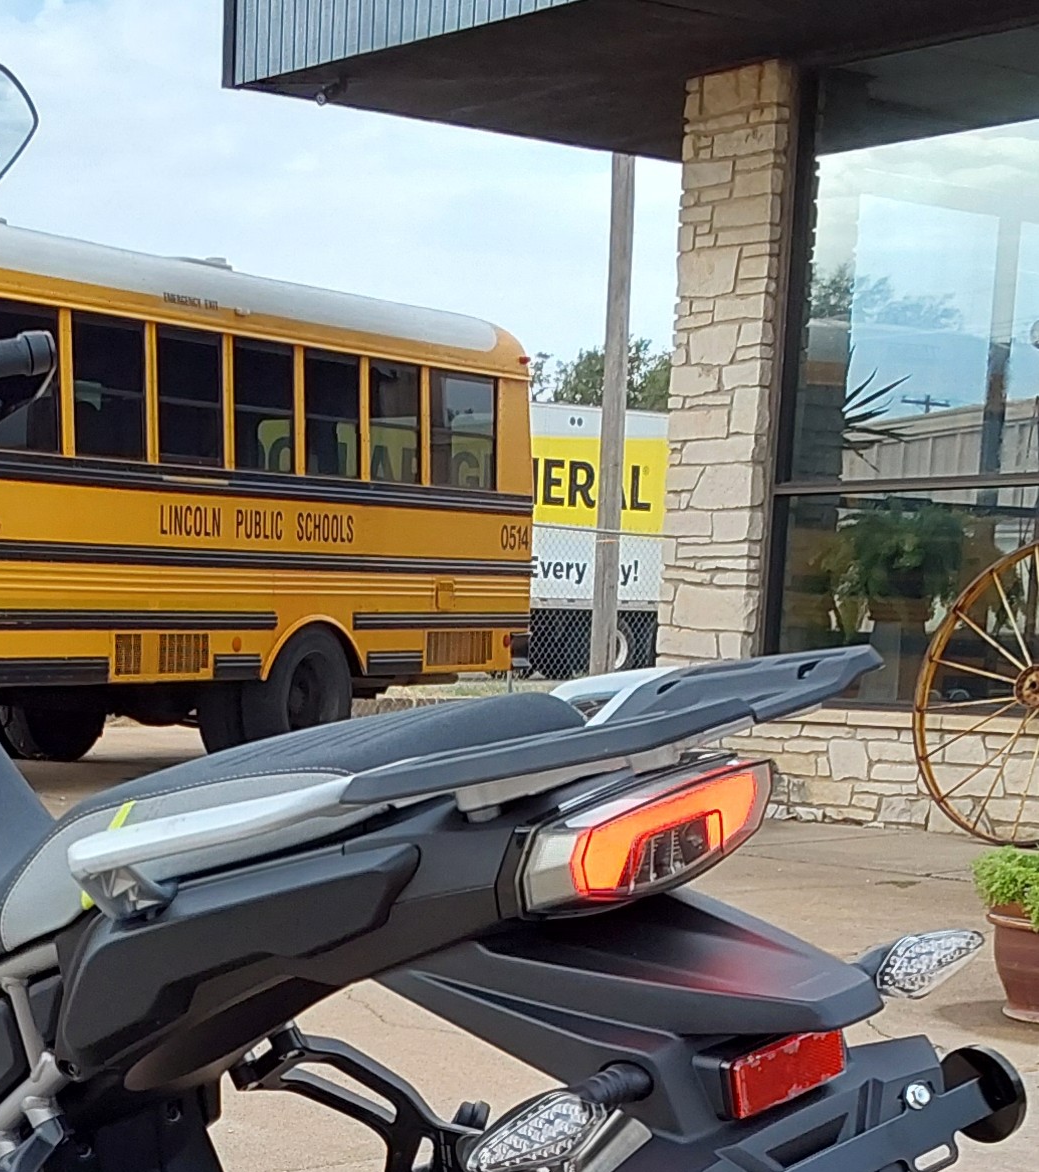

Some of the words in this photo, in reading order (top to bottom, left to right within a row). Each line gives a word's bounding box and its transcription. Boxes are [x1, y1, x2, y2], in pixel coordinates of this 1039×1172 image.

[160, 504, 222, 538] LINCOLN
[236, 508, 284, 541] PUBLIC
[297, 511, 355, 544] SCHOOLS
[500, 524, 529, 551] 0514
[532, 555, 588, 585] Every
